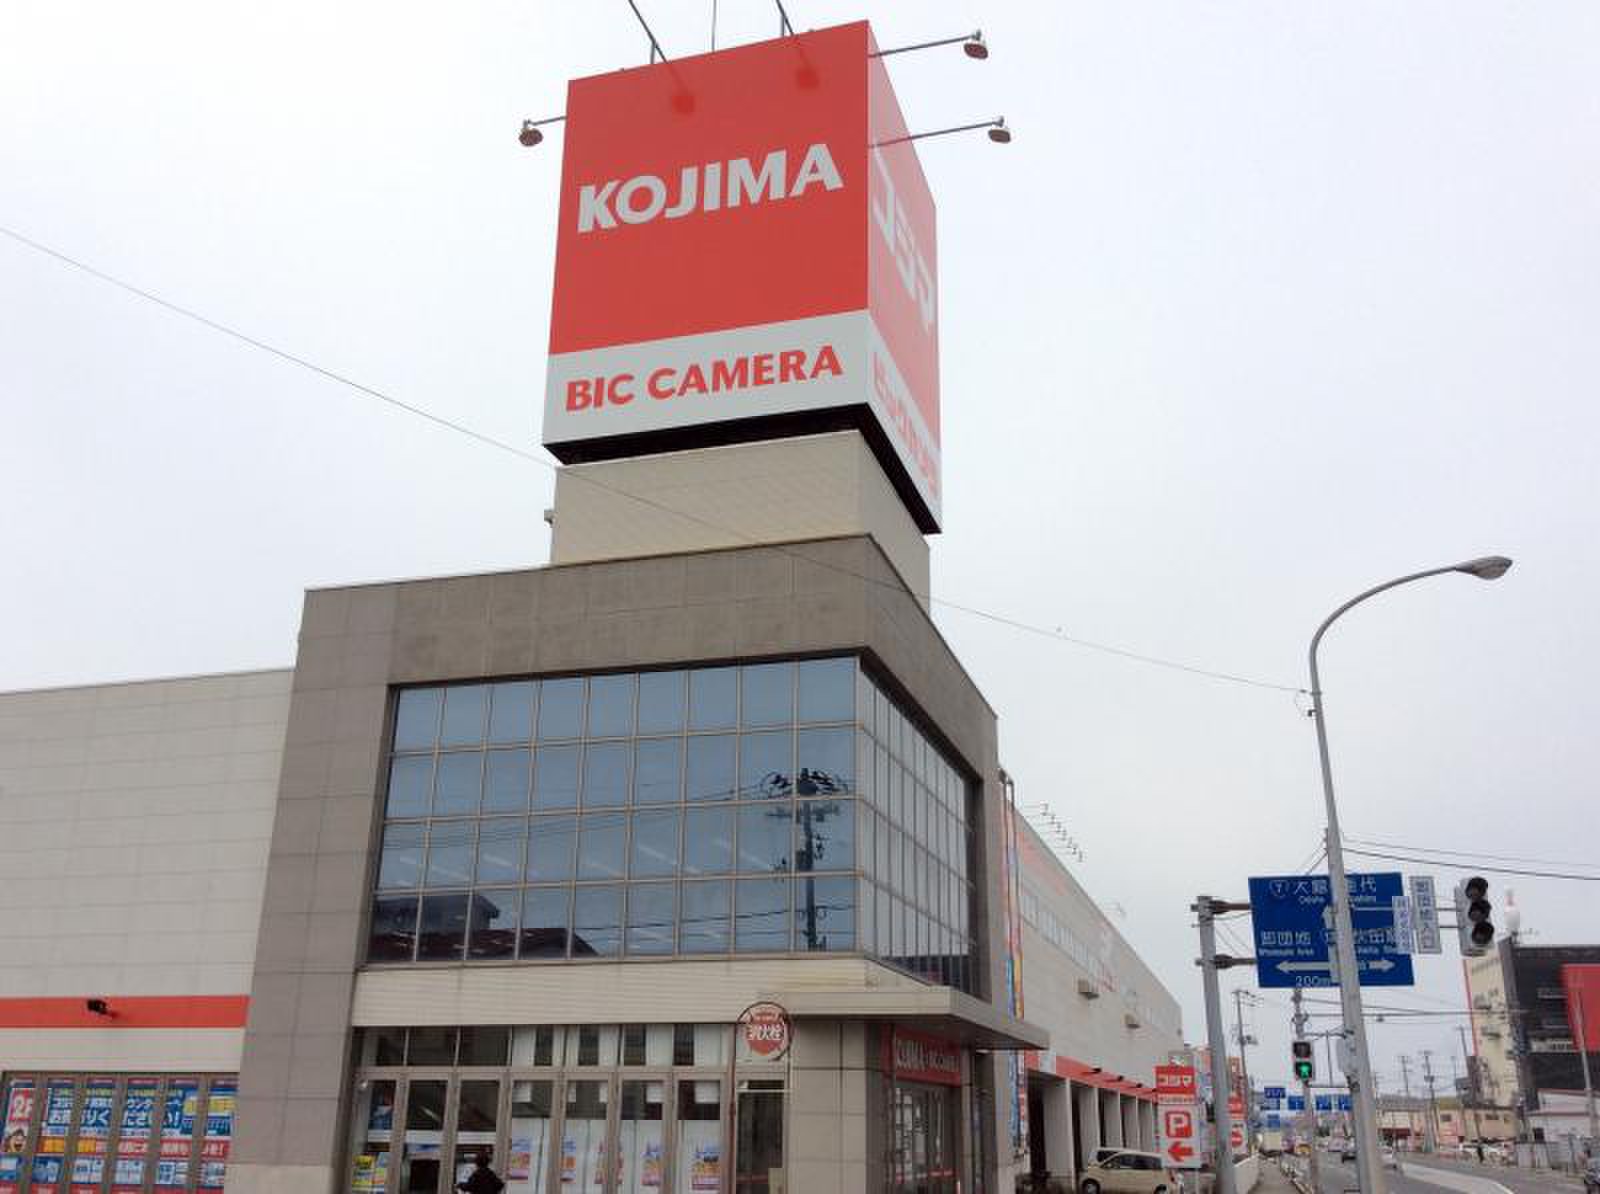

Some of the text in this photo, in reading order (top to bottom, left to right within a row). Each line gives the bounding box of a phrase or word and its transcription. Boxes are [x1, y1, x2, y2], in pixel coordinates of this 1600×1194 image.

[577, 142, 845, 234] KOJIMA
[565, 344, 843, 412] BIC CAMERA
[1169, 1112, 1188, 1137] P
